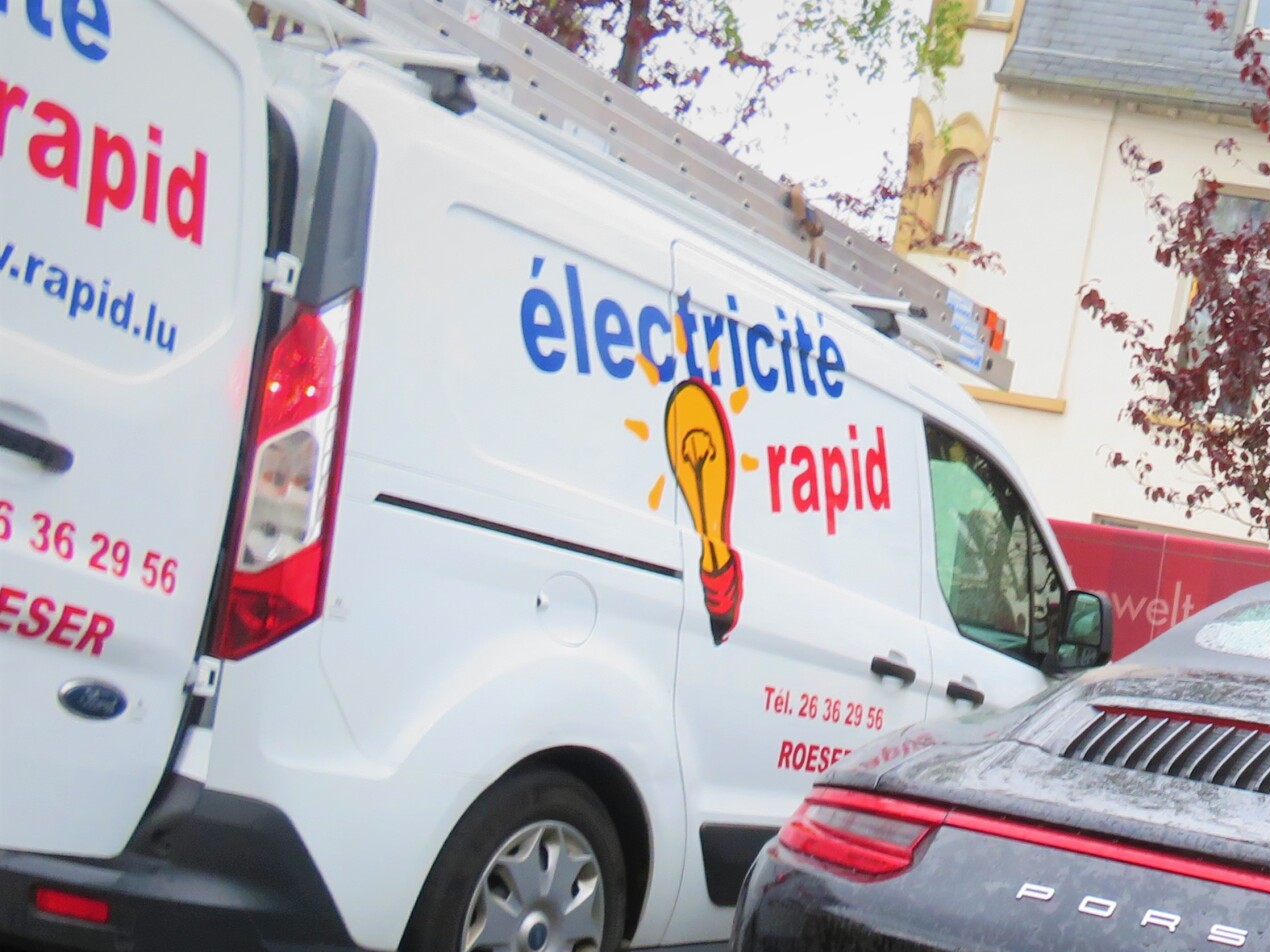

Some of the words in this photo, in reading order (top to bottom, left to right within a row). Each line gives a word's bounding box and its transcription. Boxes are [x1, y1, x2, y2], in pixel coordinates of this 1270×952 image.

[0, 78, 208, 246] rapid
[519, 257, 847, 399] électricité
[766, 424, 891, 536] rapid
[30, 512, 76, 561] 36
[88, 531, 131, 578] 29
[142, 550, 178, 595] 56
[764, 686, 793, 715] Tél.
[798, 692, 819, 719] 26
[822, 697, 842, 723] 36
[844, 702, 864, 727] 29
[866, 706, 885, 730] 56
